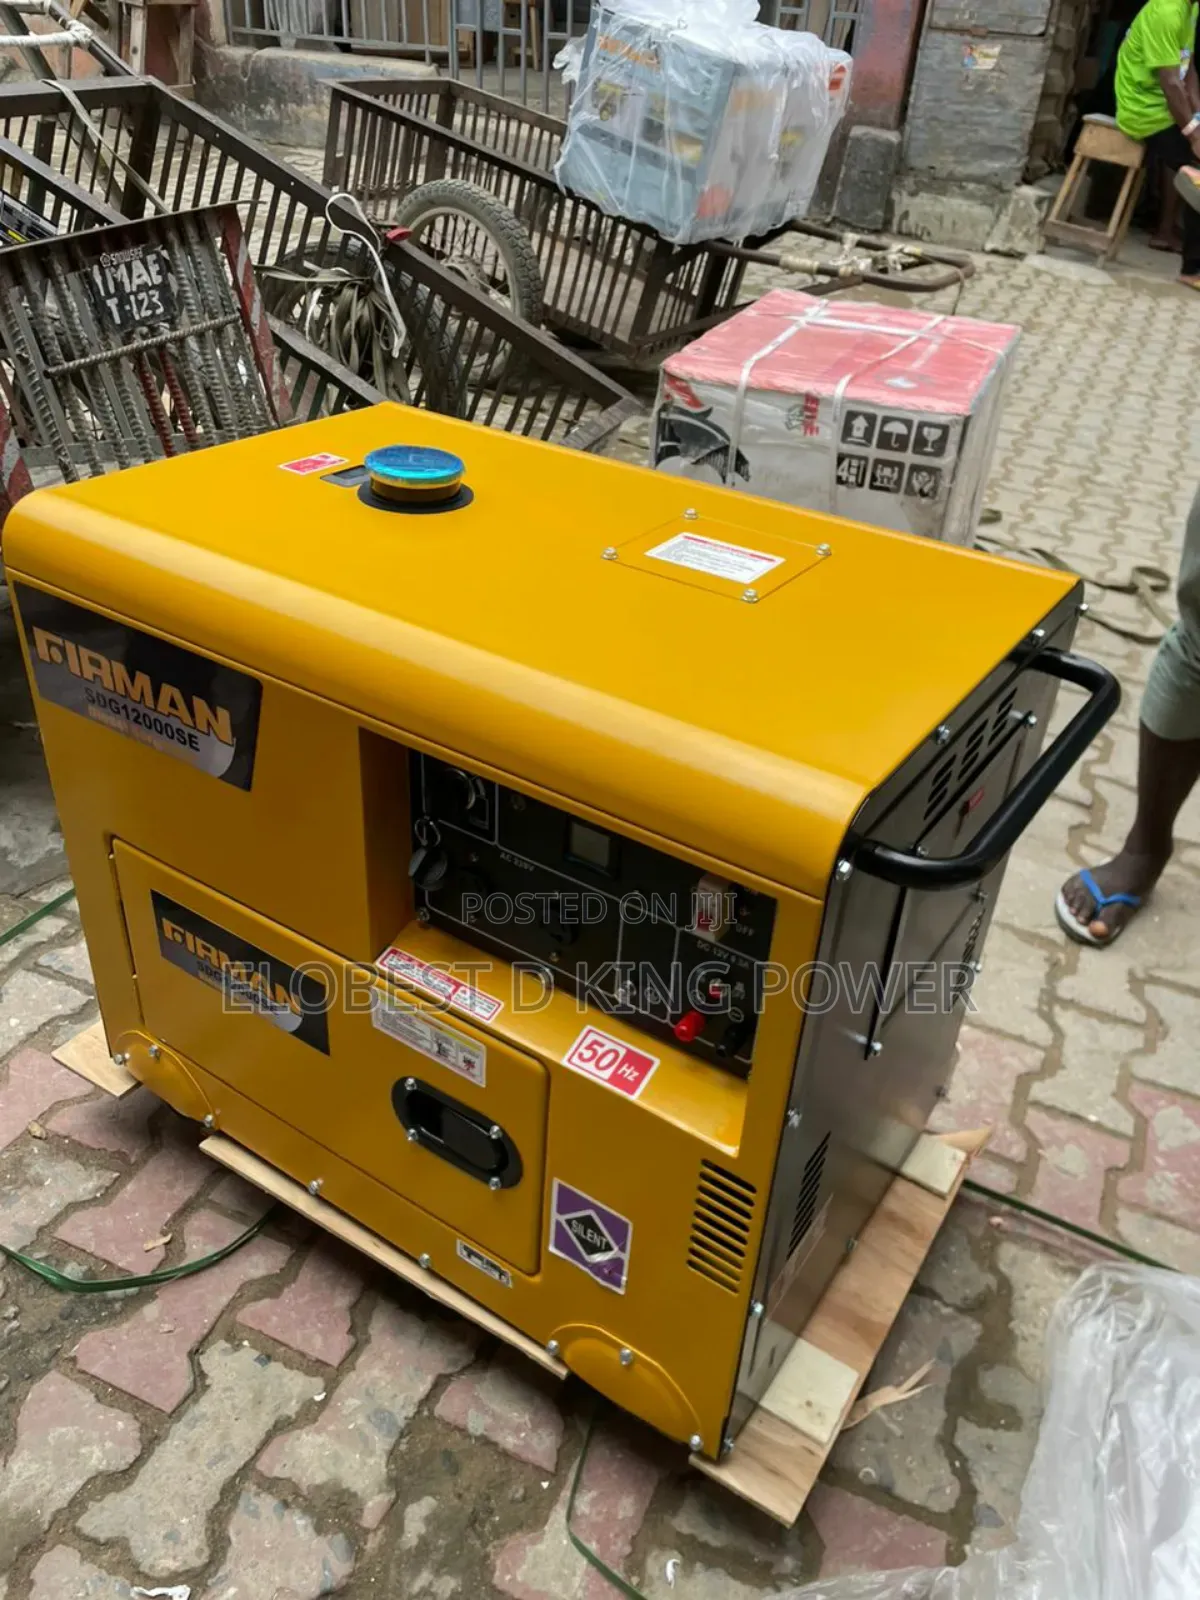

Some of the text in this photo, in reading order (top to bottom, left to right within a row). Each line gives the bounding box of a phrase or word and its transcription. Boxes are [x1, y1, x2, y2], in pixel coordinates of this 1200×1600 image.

[31, 625, 234, 747] FIRMAN
[84, 686, 201, 752] SDG12000SE
[577, 1039, 640, 1082] 50 Hz
[570, 1218, 609, 1251] SILENT
